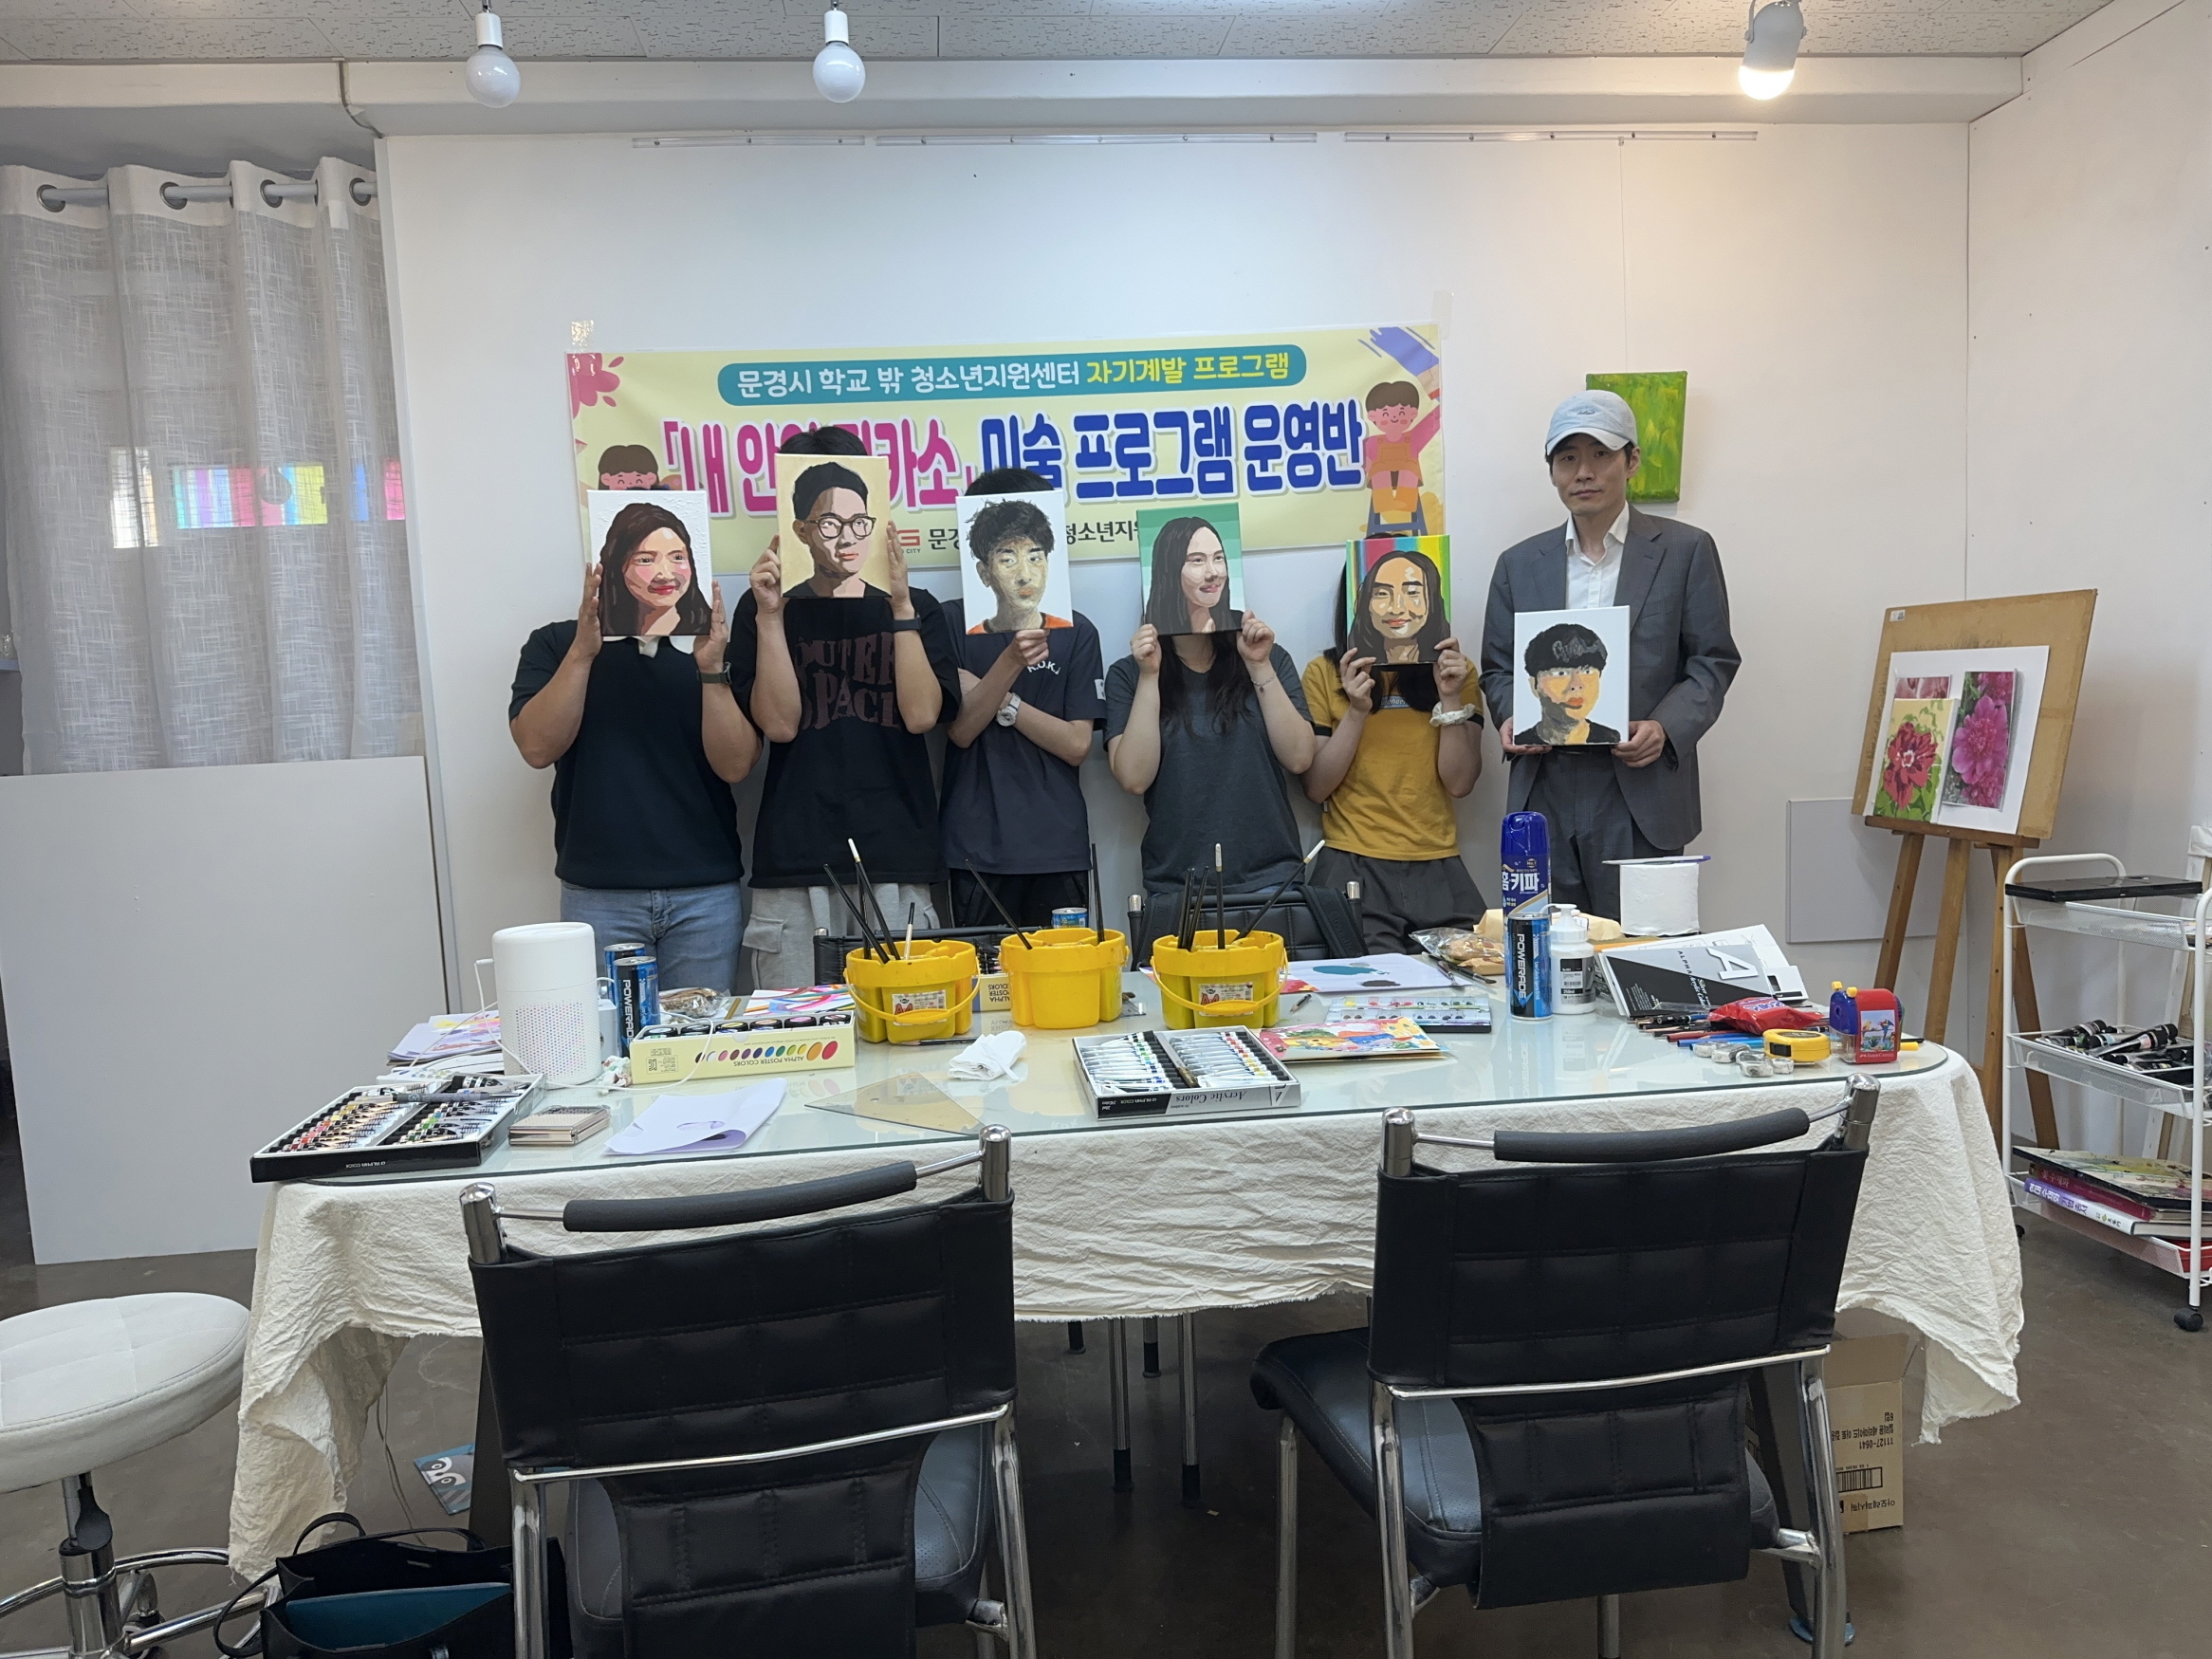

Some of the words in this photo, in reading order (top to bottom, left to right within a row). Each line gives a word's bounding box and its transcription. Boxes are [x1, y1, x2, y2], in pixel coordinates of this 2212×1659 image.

[738, 367, 812, 399] 문경시
[819, 366, 871, 396] 학교
[878, 366, 901, 395] 밖
[911, 359, 1080, 395] 청소년지원센터
[1086, 358, 1187, 385] 자기계발
[1193, 351, 1289, 380] 프로그램
[736, 421, 818, 512] 안
[1074, 405, 1234, 499] 프로그램
[1244, 399, 1364, 490] 운영반
[1502, 871, 1539, 892] 홈키파
[1517, 933, 1526, 999] POWERADE
[1677, 950, 1693, 975] ALPHA
[1175, 1093, 1207, 1104] Colors
[1210, 1091, 1248, 1101] Acrylic
[1851, 1498, 1895, 1512] 아모레퍼시픽
